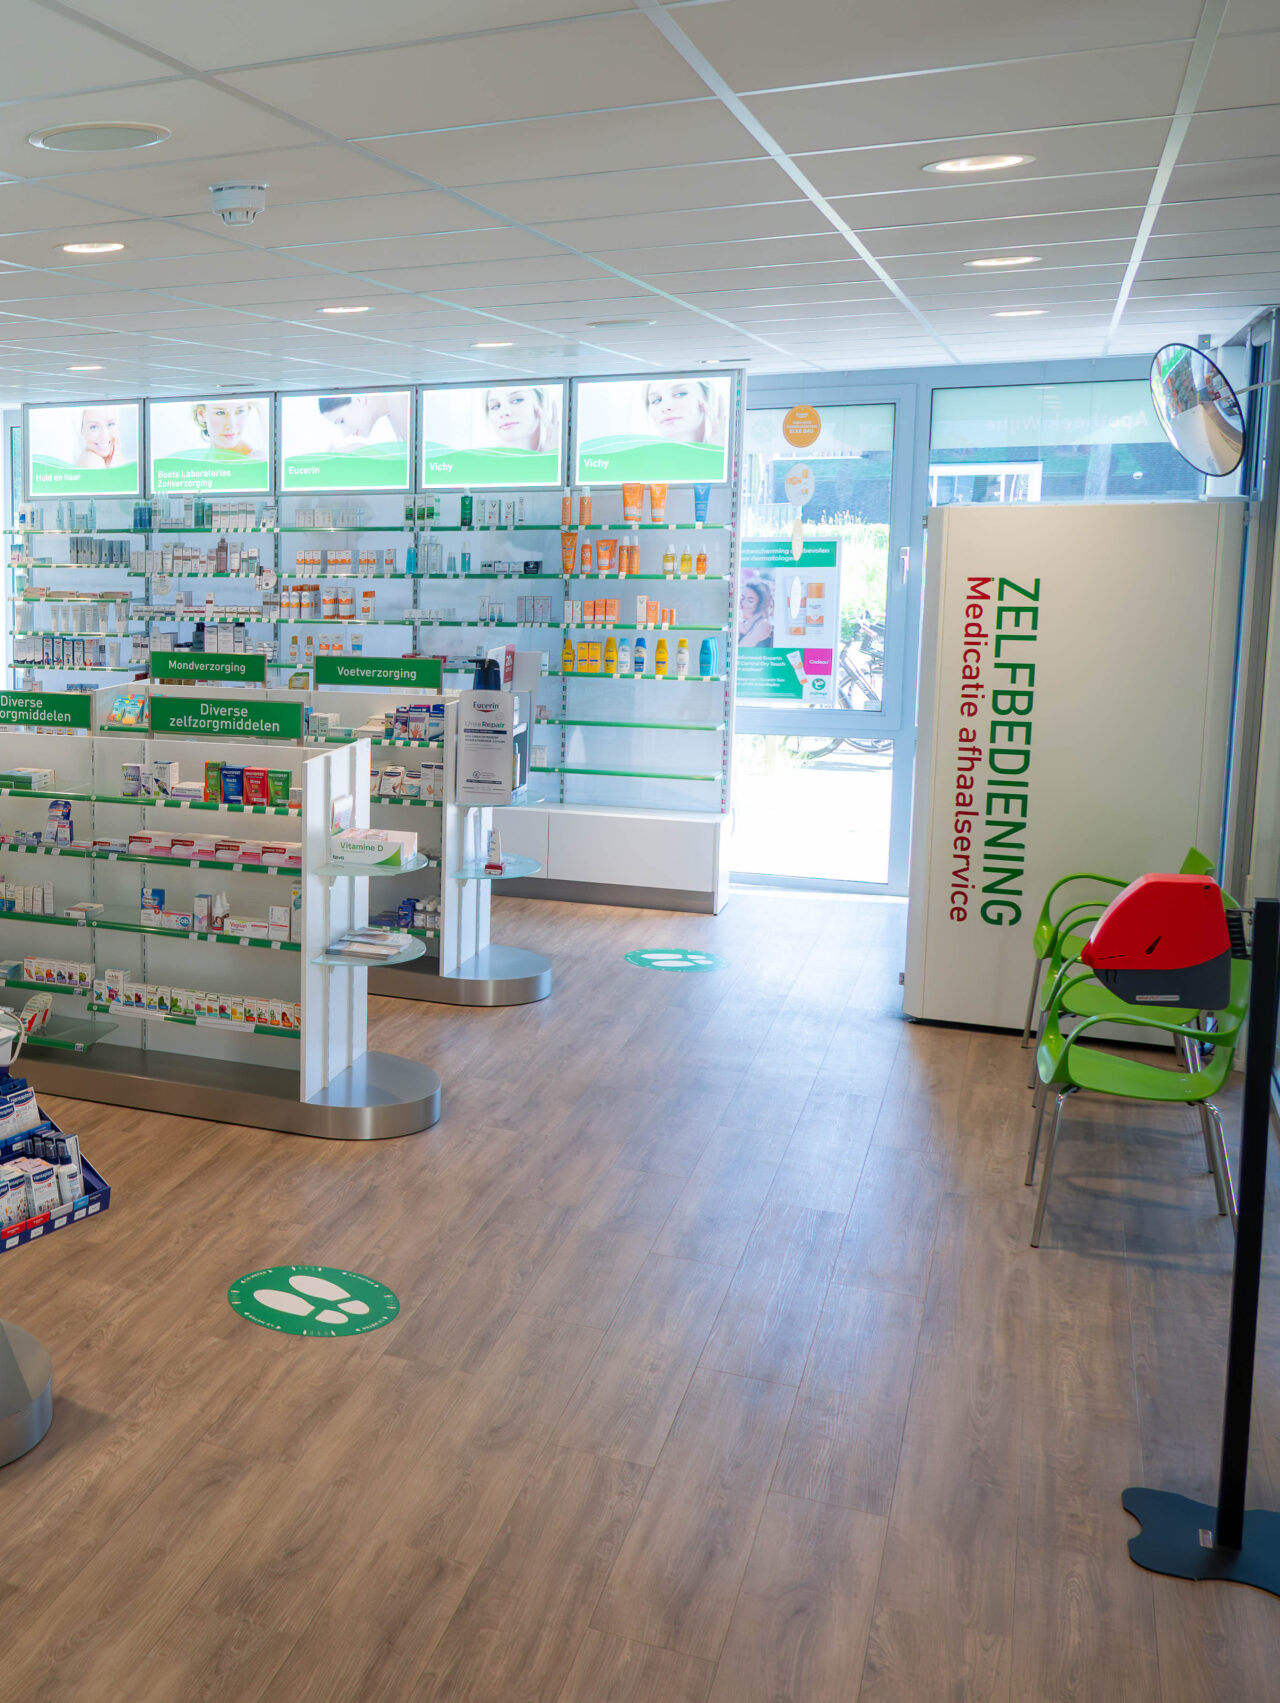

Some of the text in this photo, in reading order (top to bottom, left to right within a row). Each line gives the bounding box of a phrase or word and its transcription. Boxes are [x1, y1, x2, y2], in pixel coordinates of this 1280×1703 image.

[288, 465, 320, 475] Eucerin
[429, 461, 453, 473] Vichy
[584, 458, 610, 470] Vichy
[157, 468, 231, 479] Boots Laboratories
[157, 478, 212, 489] Zonverzorging
[168, 659, 246, 674] Mondverzorging
[337, 666, 417, 681] Voetverzorging
[0, 694, 43, 708] Diverse
[472, 700, 499, 709] Eucerin
[200, 703, 248, 718] Diverse
[169, 715, 280, 733] zelfzorgmiddelen
[949, 576, 992, 923] Medicatie afhaalservice
[980, 577, 1041, 927] ZELFBEDIENING
[339, 841, 384, 852] Vitamine D
